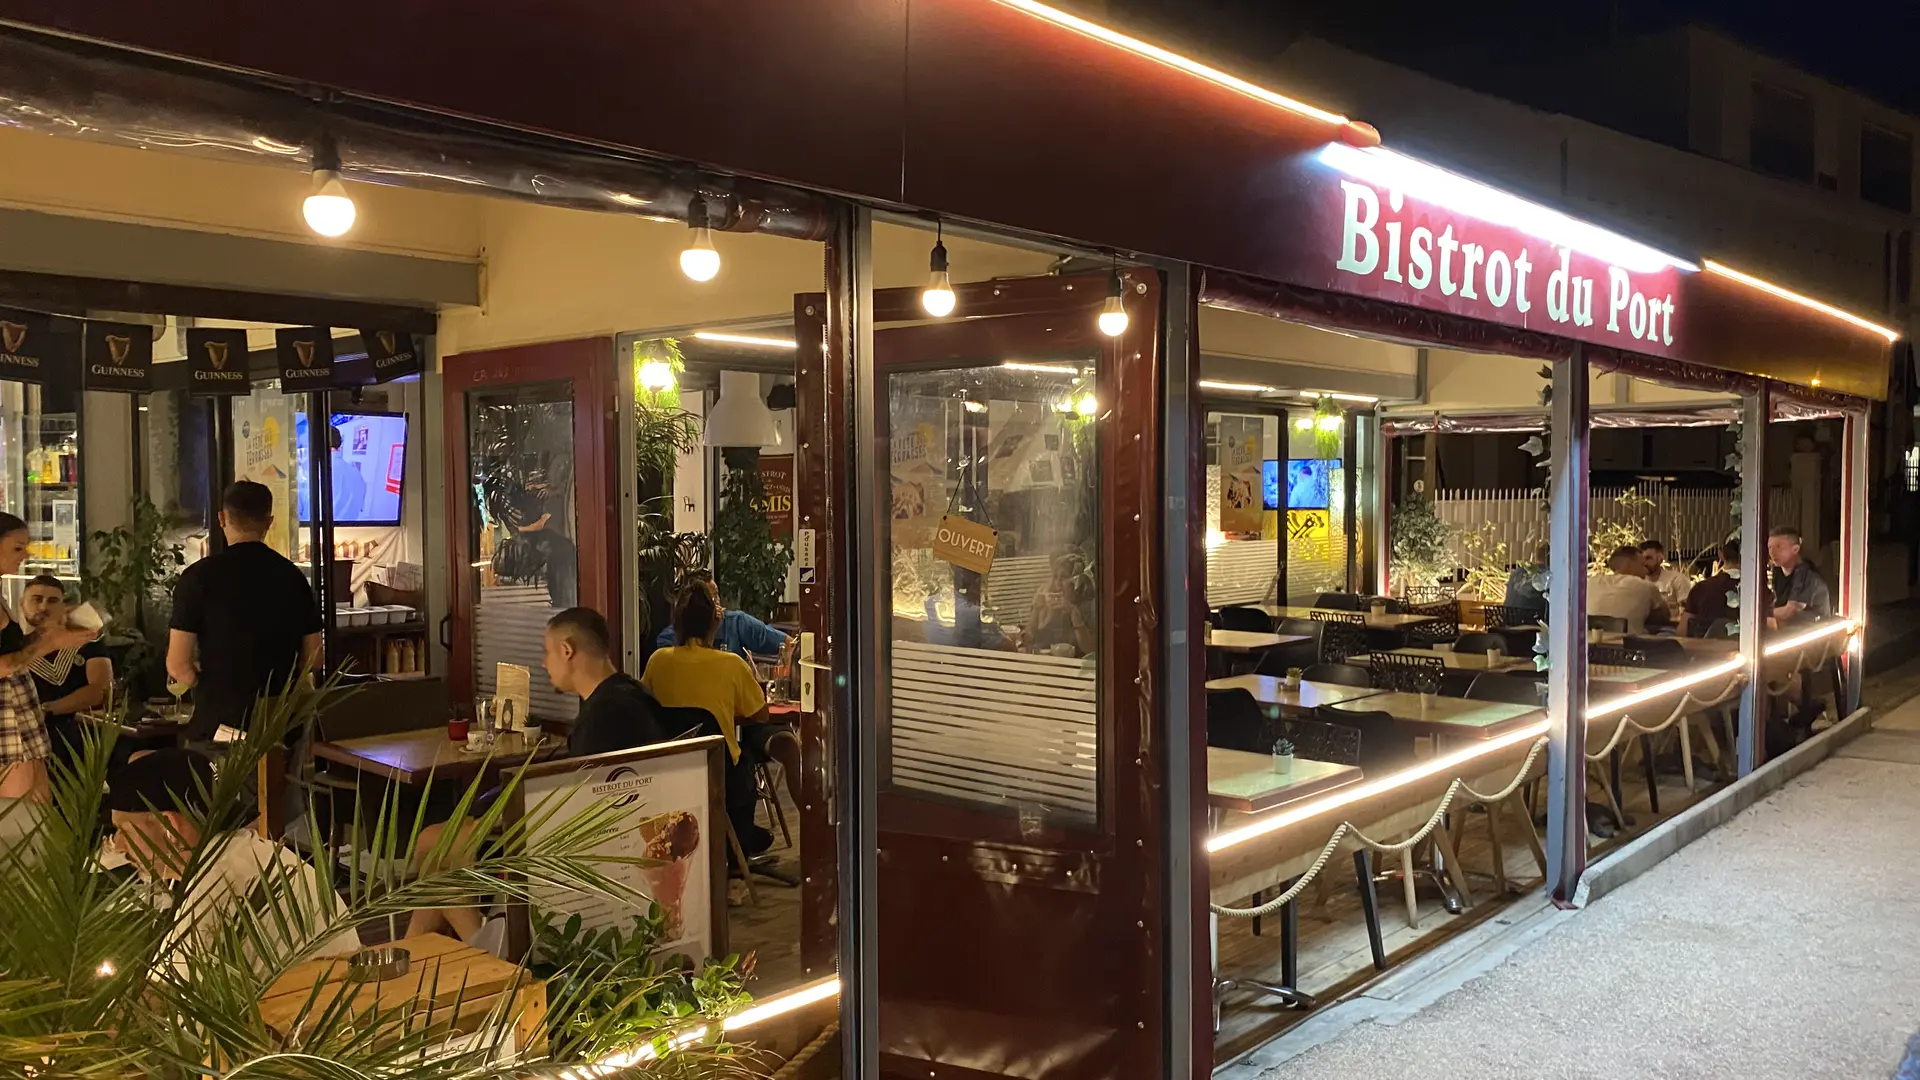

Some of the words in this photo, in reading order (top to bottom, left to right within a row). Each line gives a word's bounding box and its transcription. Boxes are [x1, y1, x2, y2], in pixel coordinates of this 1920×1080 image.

[1336, 179, 1532, 314] Bistrot
[1546, 243, 1593, 327] du
[1606, 265, 1674, 348] Port
[0, 353, 39, 368] INNESS
[375, 352, 413, 369] GUINNESS
[91, 364, 145, 378] GUINNESS
[194, 370, 243, 381] GUINNESS
[285, 368, 330, 379] GUINNESS
[754, 468, 787, 480] STROT
[938, 528, 995, 558] OUVERT
[592, 783, 621, 794] BISTROT
[623, 780, 634, 788] DU
[636, 776, 653, 786] PORT
